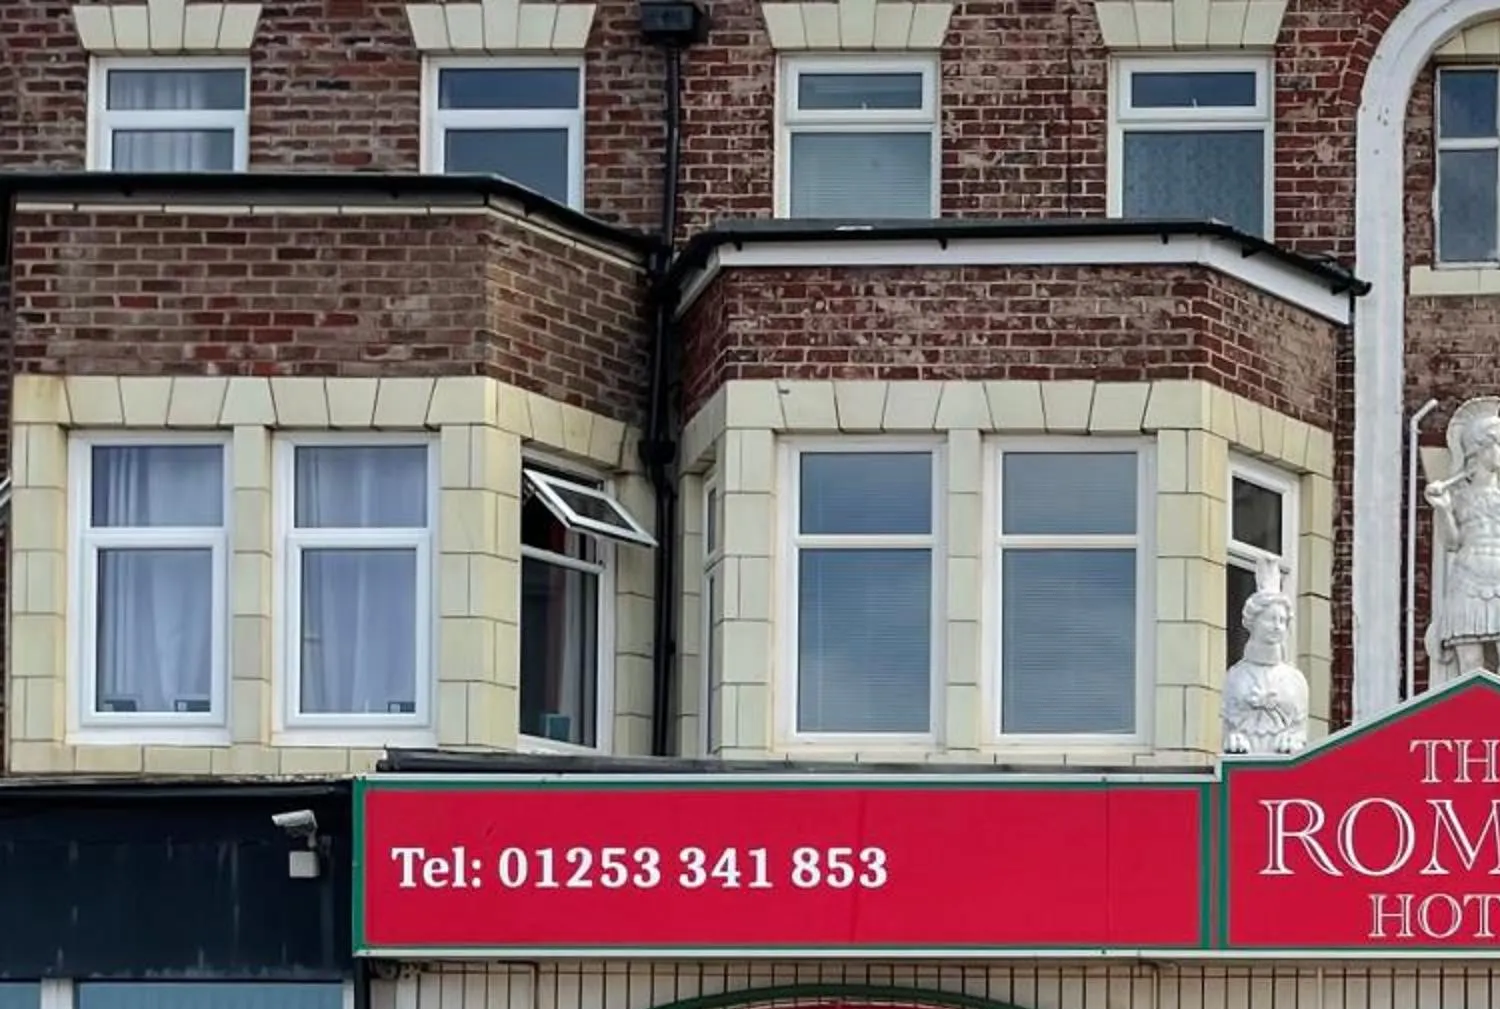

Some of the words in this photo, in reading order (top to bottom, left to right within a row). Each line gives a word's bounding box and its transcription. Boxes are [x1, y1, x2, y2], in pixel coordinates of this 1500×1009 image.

[391, 846, 483, 888] Tel:
[498, 847, 661, 888] 01253
[679, 846, 773, 888] 341
[791, 847, 888, 889] 853
